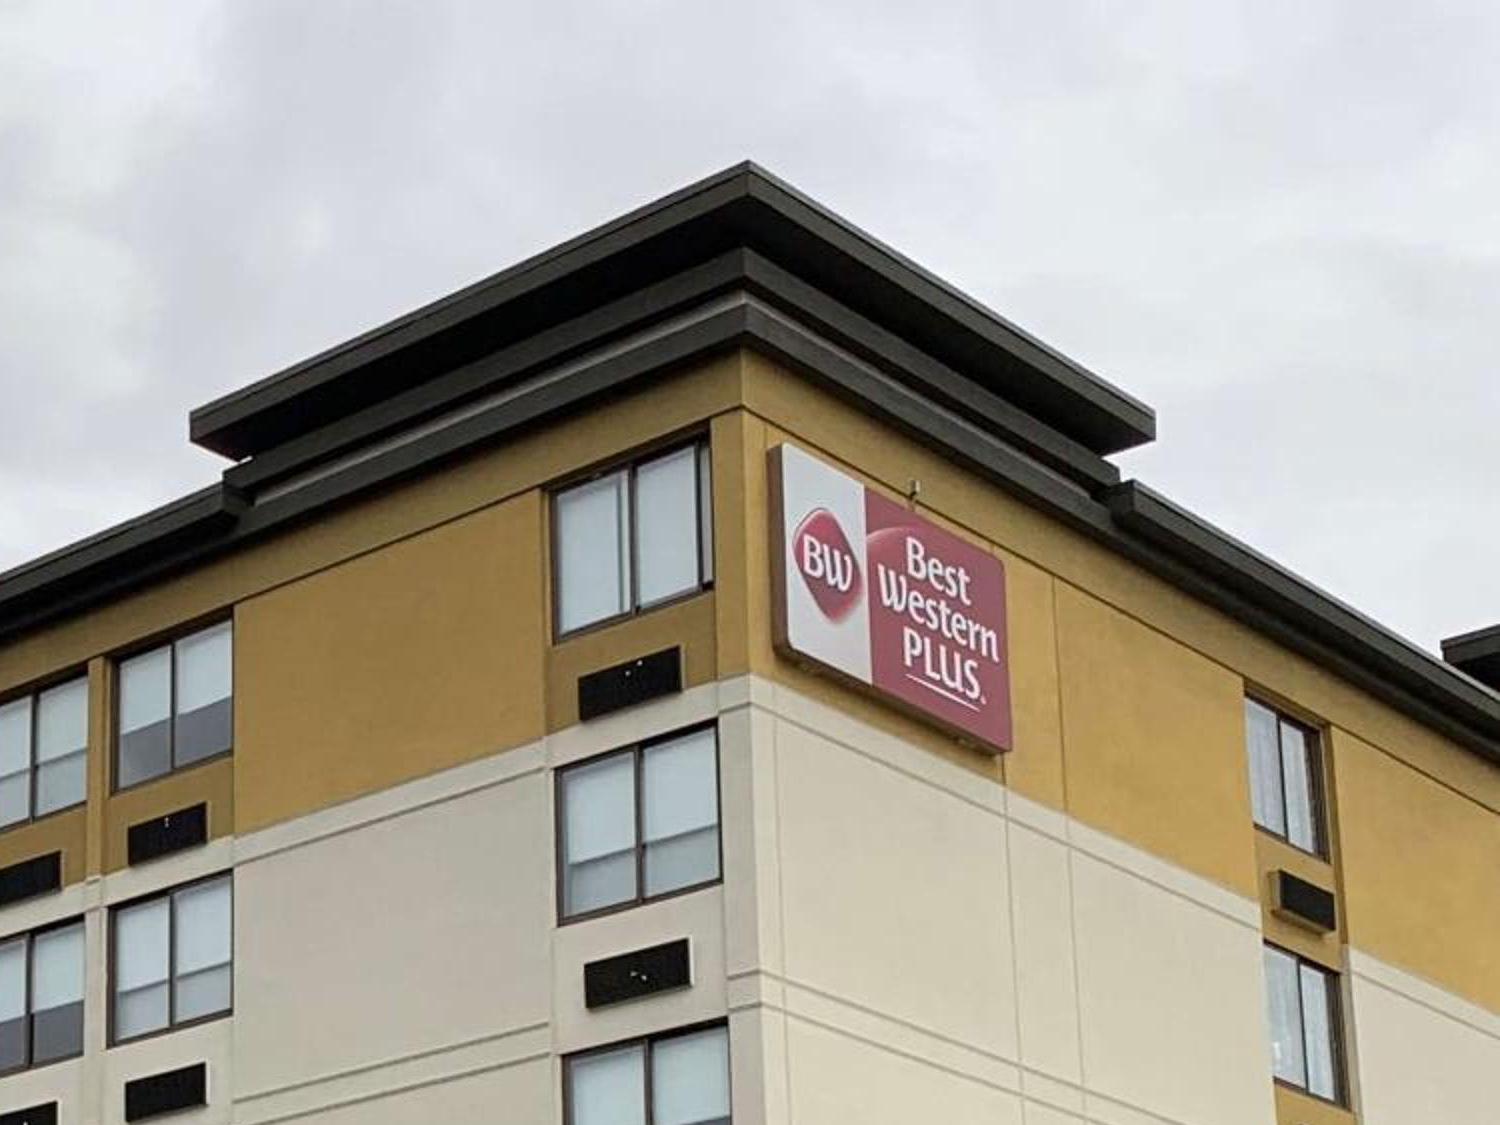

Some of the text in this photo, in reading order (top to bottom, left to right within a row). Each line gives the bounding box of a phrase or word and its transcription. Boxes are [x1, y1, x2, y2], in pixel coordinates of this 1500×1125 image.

[803, 533, 853, 591] BW
[906, 536, 972, 606] Best
[877, 563, 1000, 663] Western
[903, 626, 981, 700] PLUS
